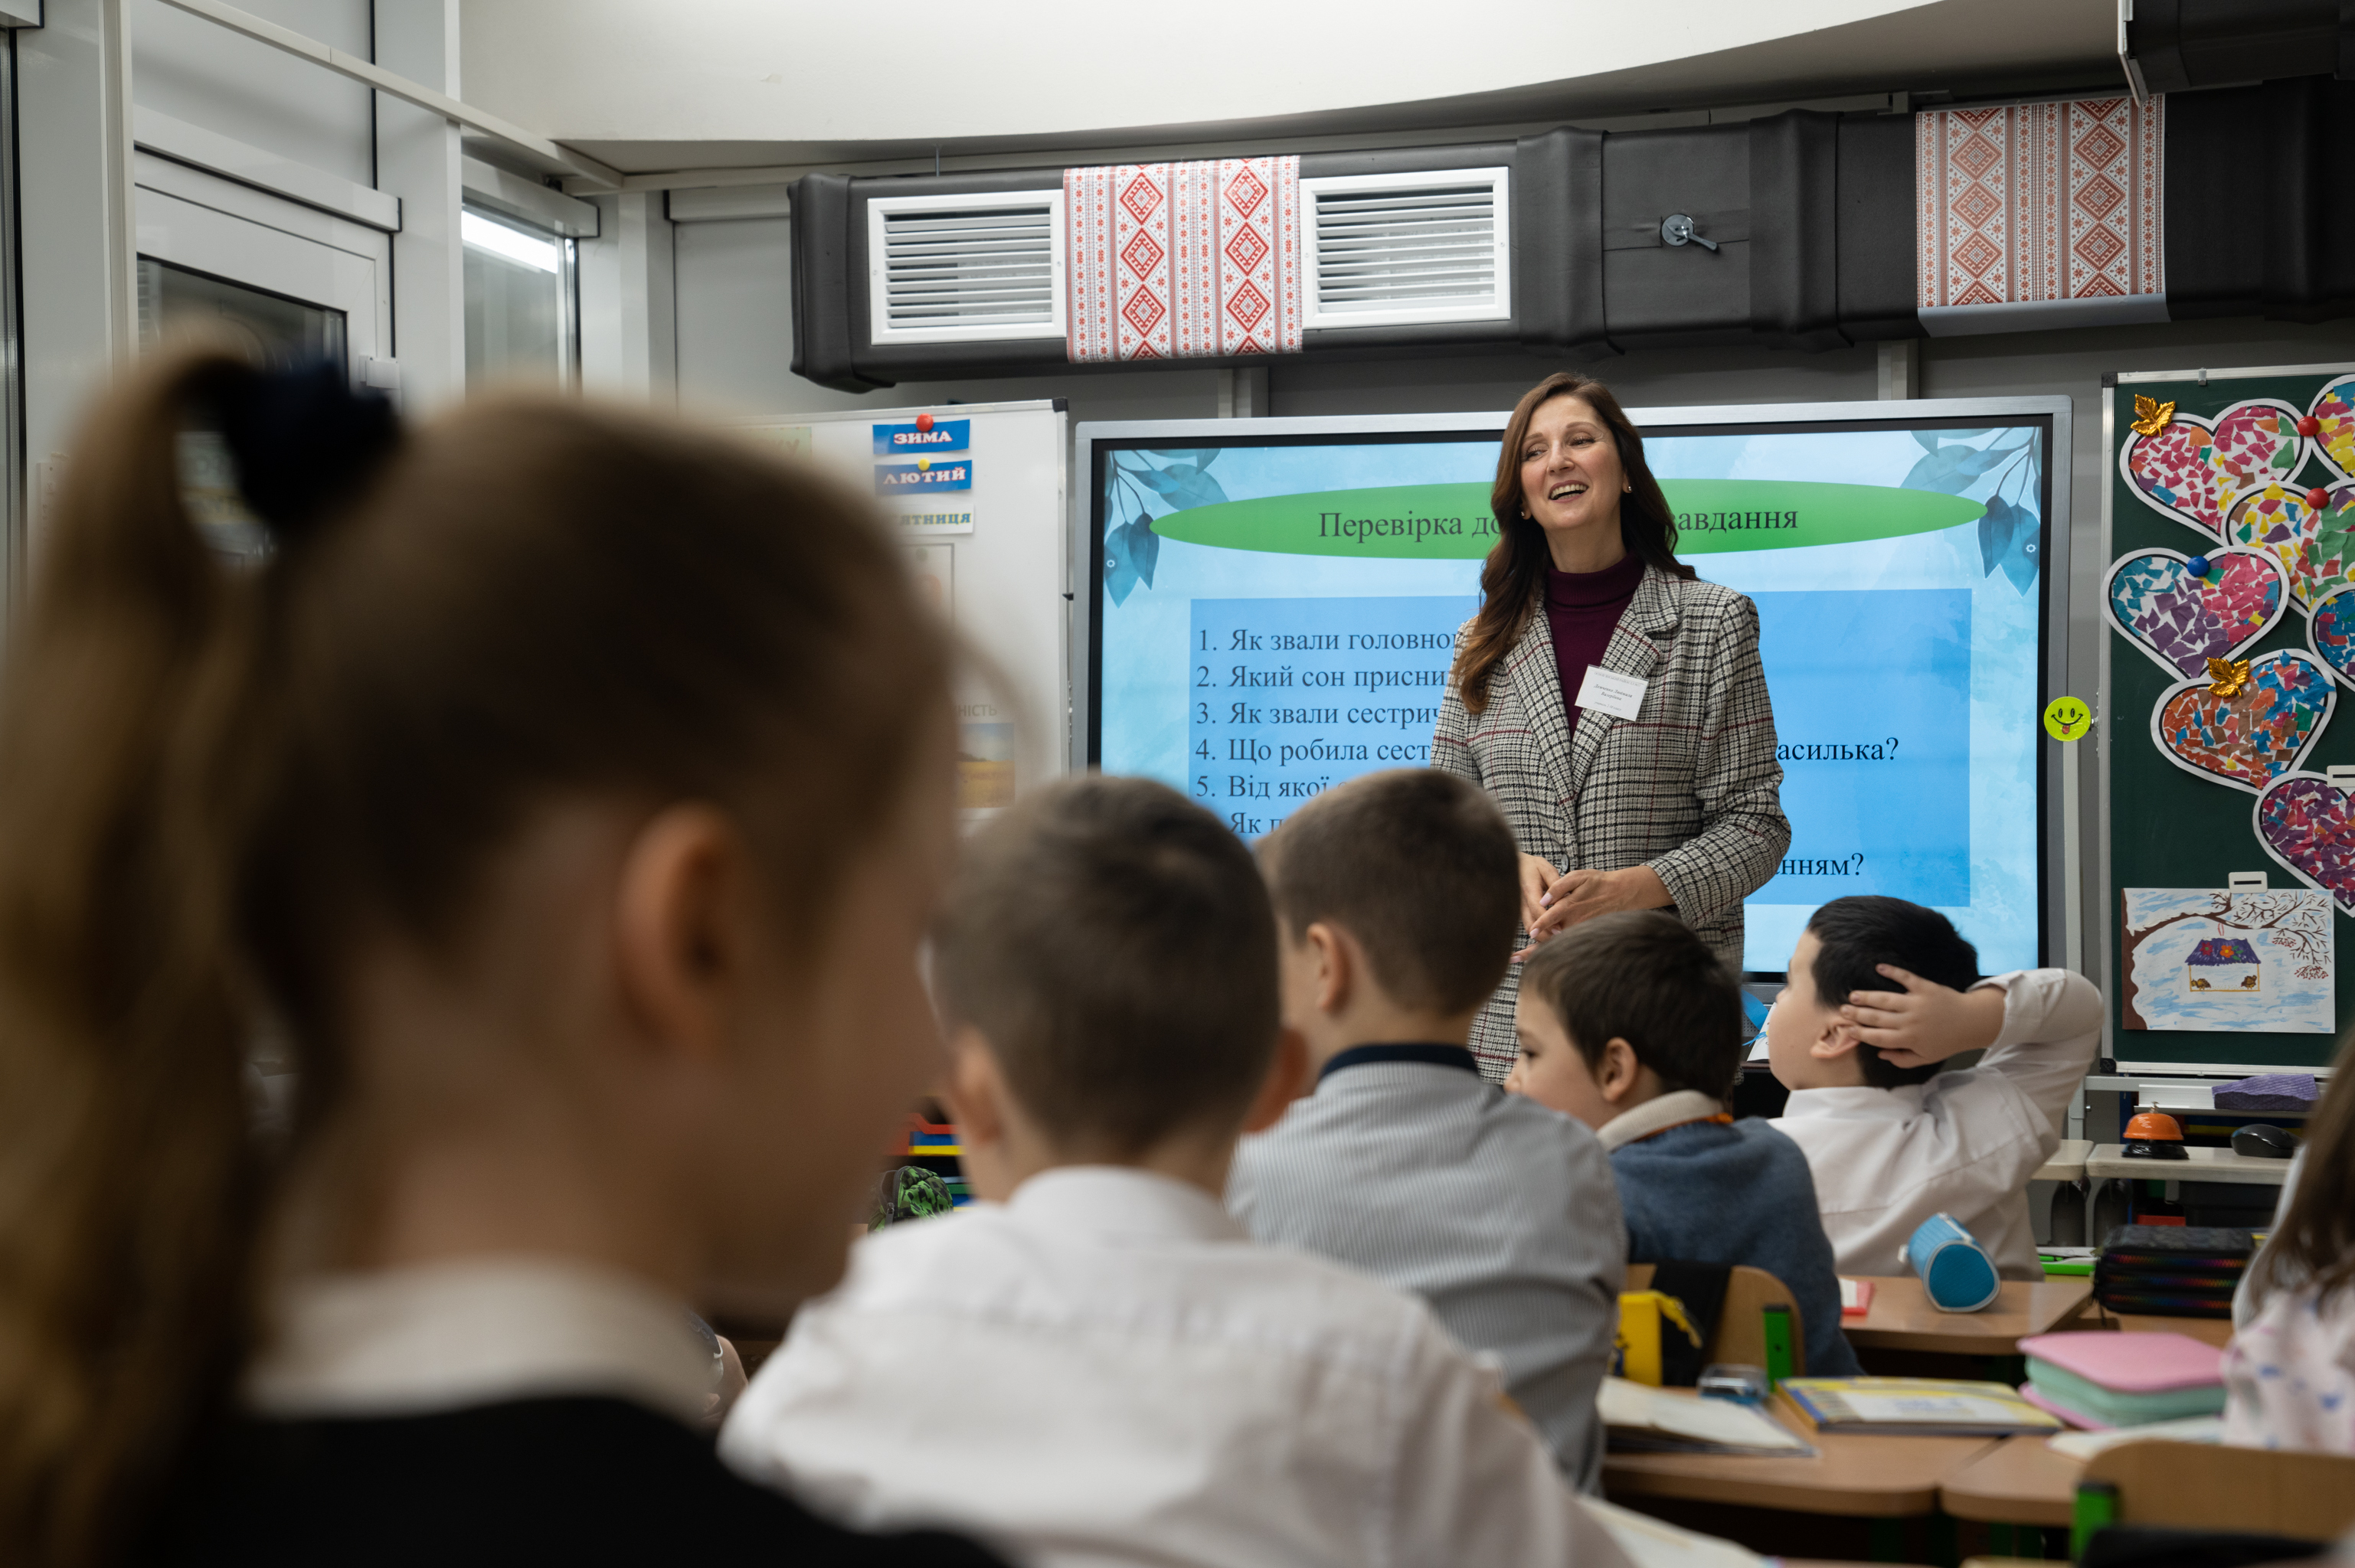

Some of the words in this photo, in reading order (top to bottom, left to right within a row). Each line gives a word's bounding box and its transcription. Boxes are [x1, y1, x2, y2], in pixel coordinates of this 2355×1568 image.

[893, 430, 953, 445] ЗИМА
[882, 466, 967, 485] ЛЮТИЙ
[900, 512, 972, 526] ЯТНИЦЯ
[1318, 510, 1464, 544] Перевірка
[1472, 517, 1500, 538] до
[1672, 511, 1799, 534] авдання
[1199, 629, 1218, 651] 1.
[1228, 629, 1263, 651] Як
[1270, 634, 1339, 651] звали
[1195, 665, 1217, 688] 2.
[1228, 665, 1294, 688] Який
[1302, 671, 1346, 687] сон
[1353, 670, 1450, 693] присни
[957, 704, 997, 717] НІСТЬ
[1196, 702, 1217, 724] 3.
[1227, 702, 1262, 724] Як
[1269, 707, 1339, 724] звали
[1195, 738, 1216, 760] 4.
[1228, 739, 1271, 766] Що
[1279, 737, 1369, 766] робила
[1376, 744, 1431, 761] сест
[1777, 737, 1899, 760] асилька?
[1196, 776, 1215, 798] 5.
[1228, 775, 1271, 801] Від
[1277, 776, 1330, 798] якої
[1230, 812, 1261, 834] Як
[1775, 852, 1864, 876] нням?
